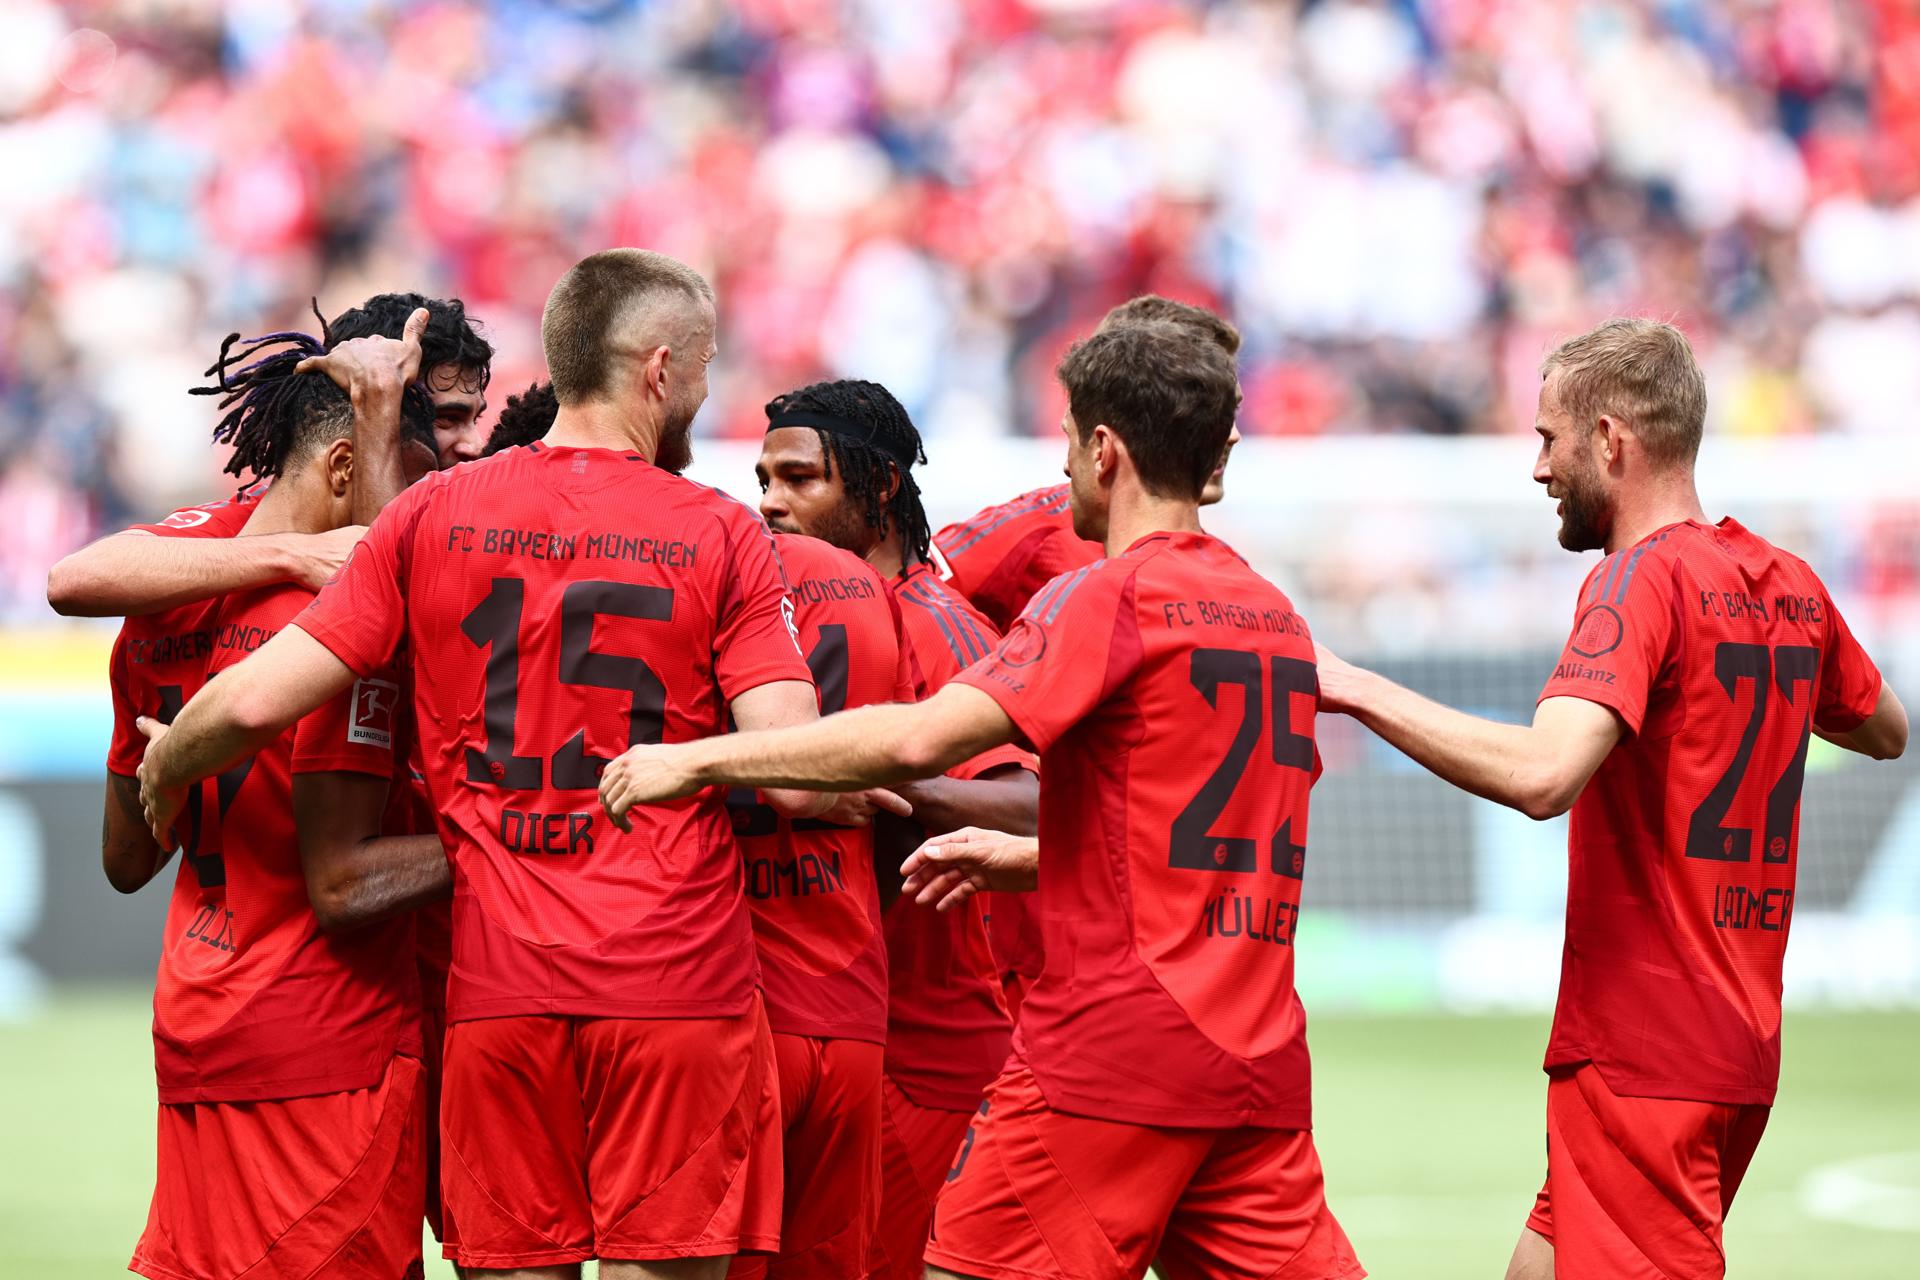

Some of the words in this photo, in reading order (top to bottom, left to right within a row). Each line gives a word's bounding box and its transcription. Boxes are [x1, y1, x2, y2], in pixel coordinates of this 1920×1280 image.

[448, 526, 475, 552] FC
[483, 528, 576, 560] BAYERN
[585, 533, 697, 568] MÜNCHEN
[1163, 602, 1193, 629] FC
[1197, 601, 1260, 631] BAYERN
[1700, 590, 1721, 616] FC
[460, 577, 674, 790] 15
[1552, 663, 1617, 686] Allianz
[1168, 647, 1316, 881] 25
[1685, 641, 1820, 864] 27
[501, 808, 594, 855] DIER
[1714, 884, 1792, 931] LAIMER
